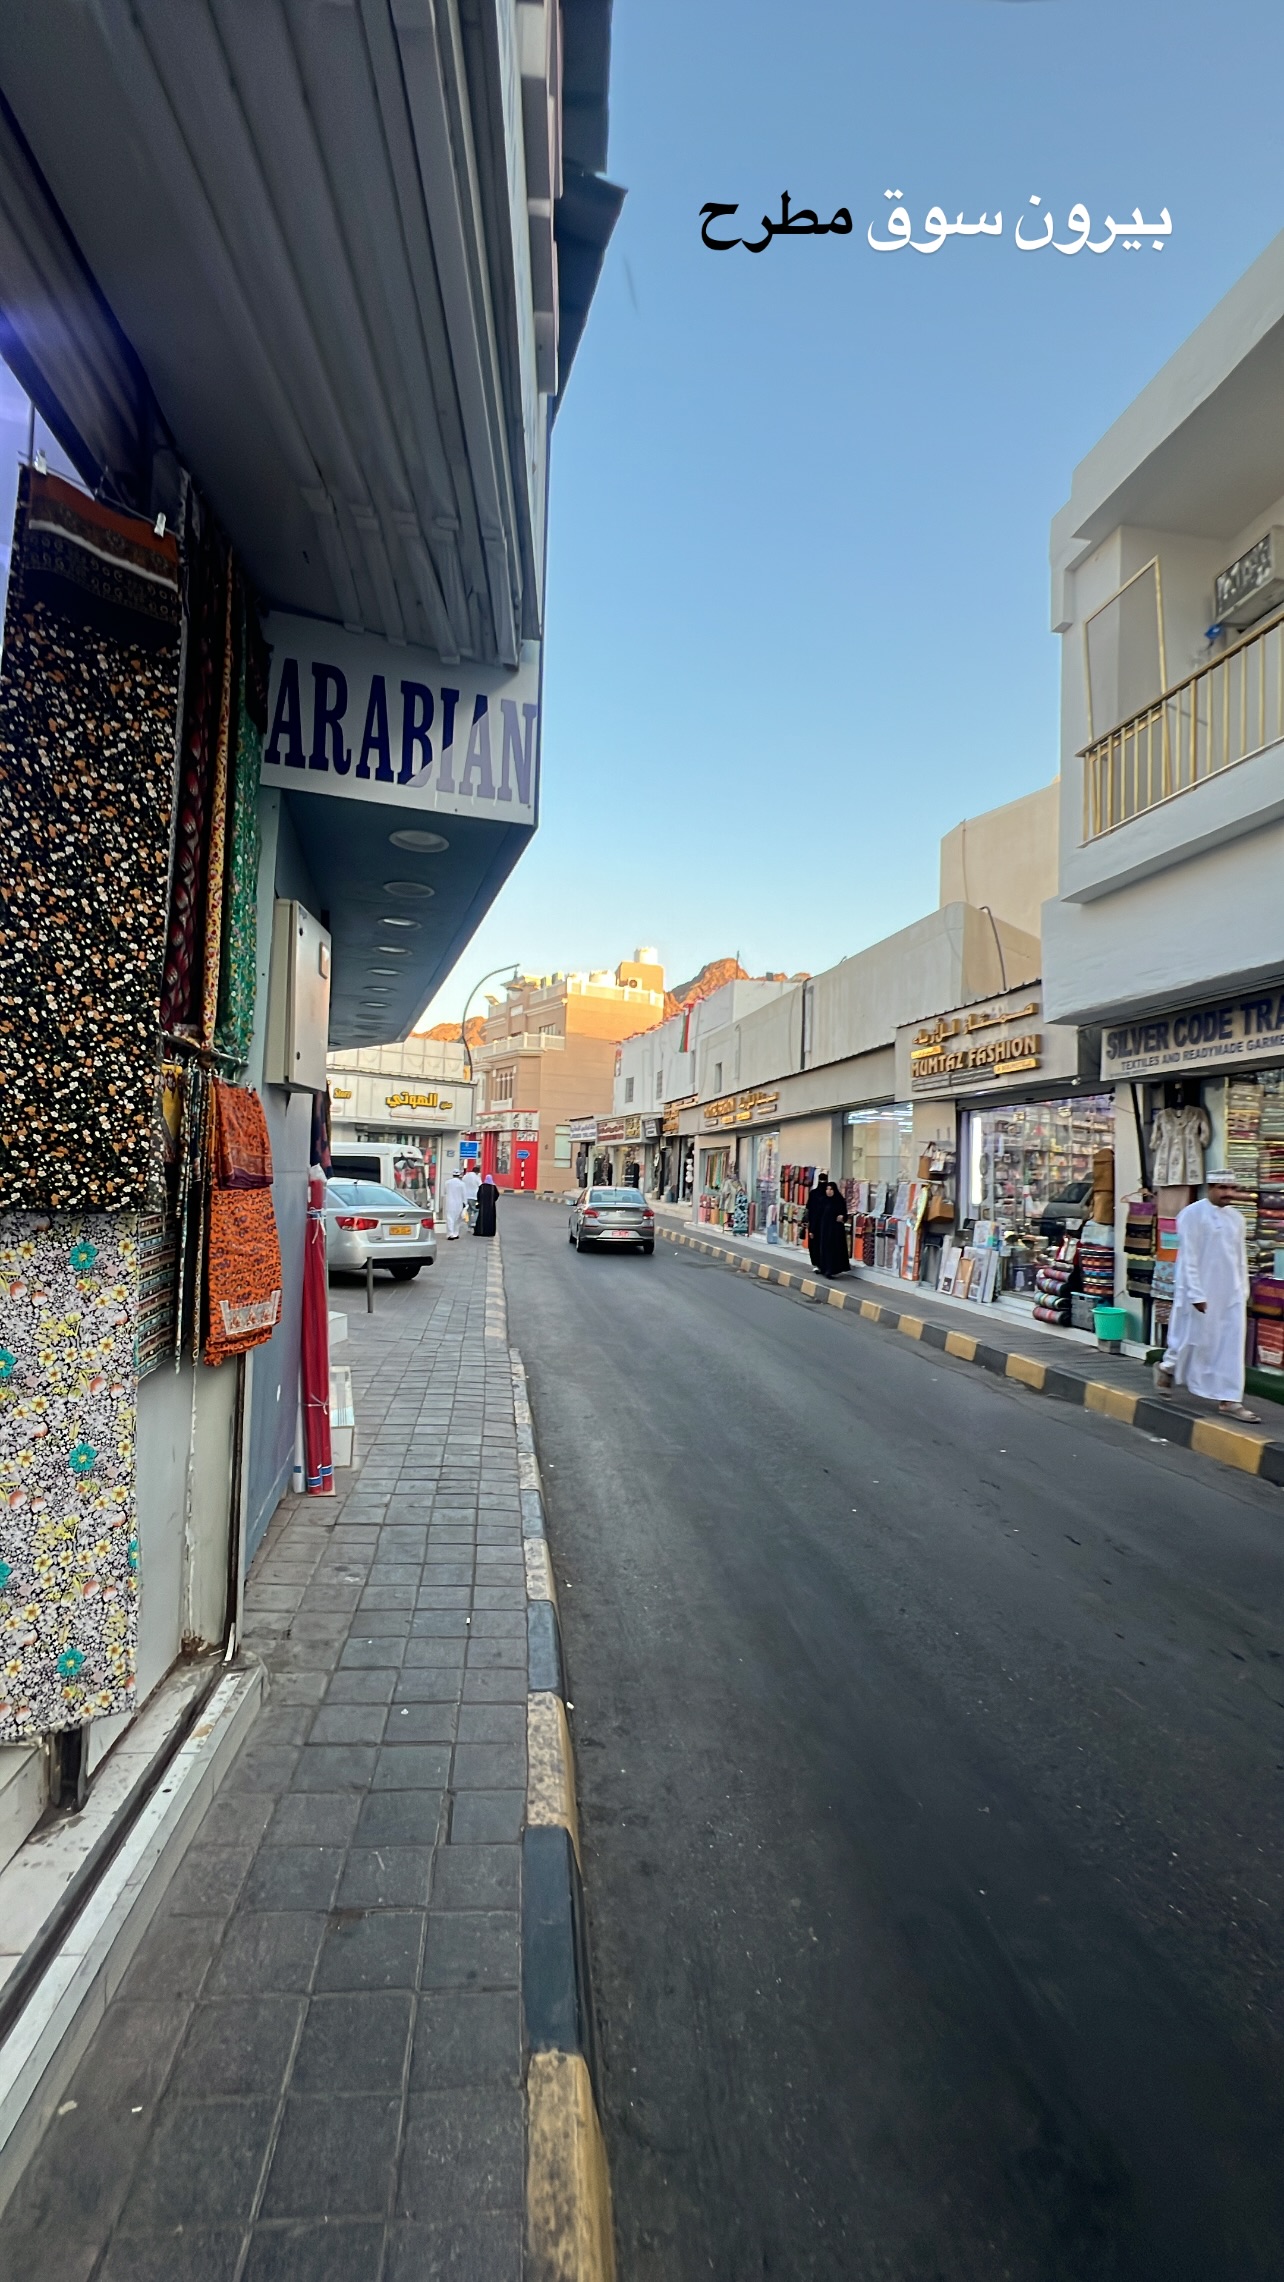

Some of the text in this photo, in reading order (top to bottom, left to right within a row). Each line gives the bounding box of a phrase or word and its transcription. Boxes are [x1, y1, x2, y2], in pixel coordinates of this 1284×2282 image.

[264, 658, 537, 804] ARABIAN
[1106, 1021, 1170, 1060] SILVER
[1173, 1007, 1233, 1048] CODE
[911, 1051, 965, 1078] MUMTAZ
[968, 1034, 1041, 1068] FASHION
[1121, 1056, 1160, 1071] TEXTILES
[1162, 1052, 1181, 1064] AND
[1182, 1041, 1243, 1061] READYMADE
[385, 1091, 438, 1109] الهوتي
